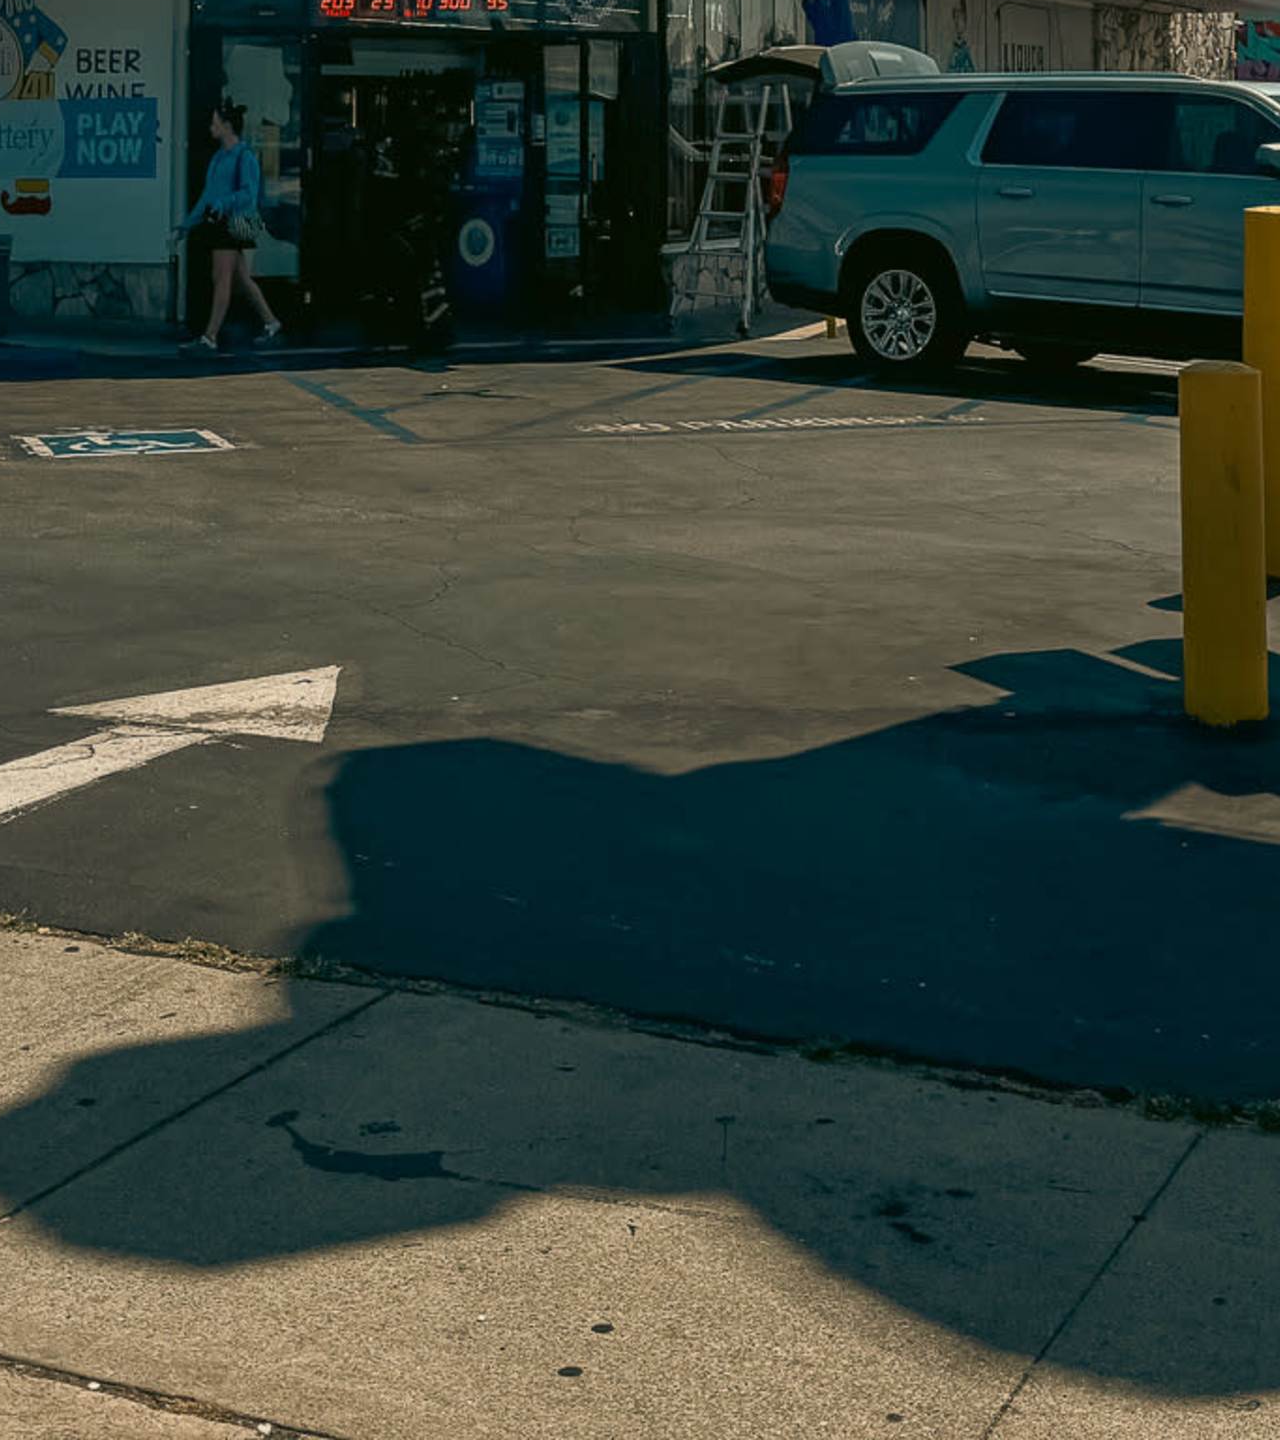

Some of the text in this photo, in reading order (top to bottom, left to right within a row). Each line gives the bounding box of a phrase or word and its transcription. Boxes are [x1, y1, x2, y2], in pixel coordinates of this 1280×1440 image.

[76, 49, 141, 74] BEER
[76, 112, 145, 137] PLAY
[76, 138, 143, 167] NOW
